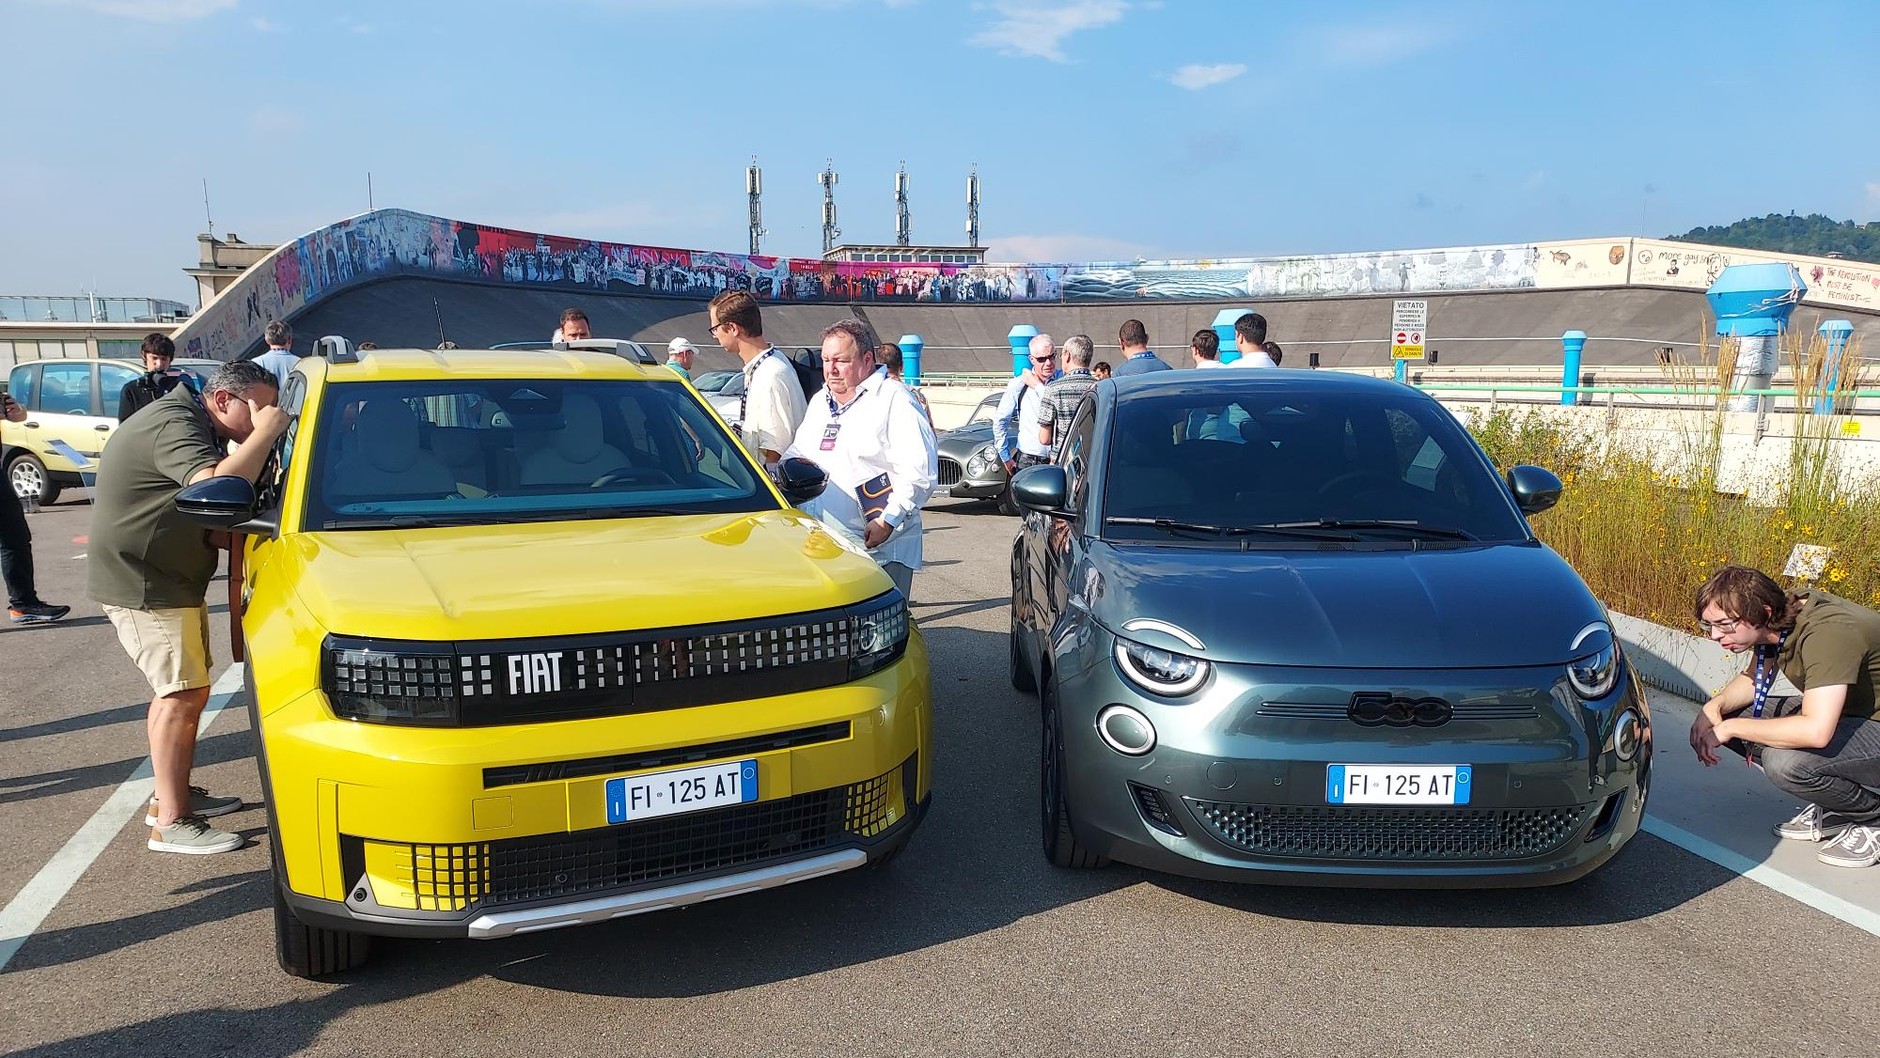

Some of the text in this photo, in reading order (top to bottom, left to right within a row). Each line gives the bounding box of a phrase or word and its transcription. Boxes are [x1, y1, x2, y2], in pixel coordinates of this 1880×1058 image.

[1658, 252, 1682, 260] more
[1683, 254, 1699, 266] gay
[1827, 267, 1871, 283] THE REVOLUTION
[1827, 291, 1861, 302] FEMINIST
[1843, 283, 1853, 291] BE
[507, 652, 563, 695] FIAT
[1347, 691, 1454, 728] 500
[631, 772, 739, 811] FI 125 AT
[1349, 774, 1454, 796] FI 125 AT
